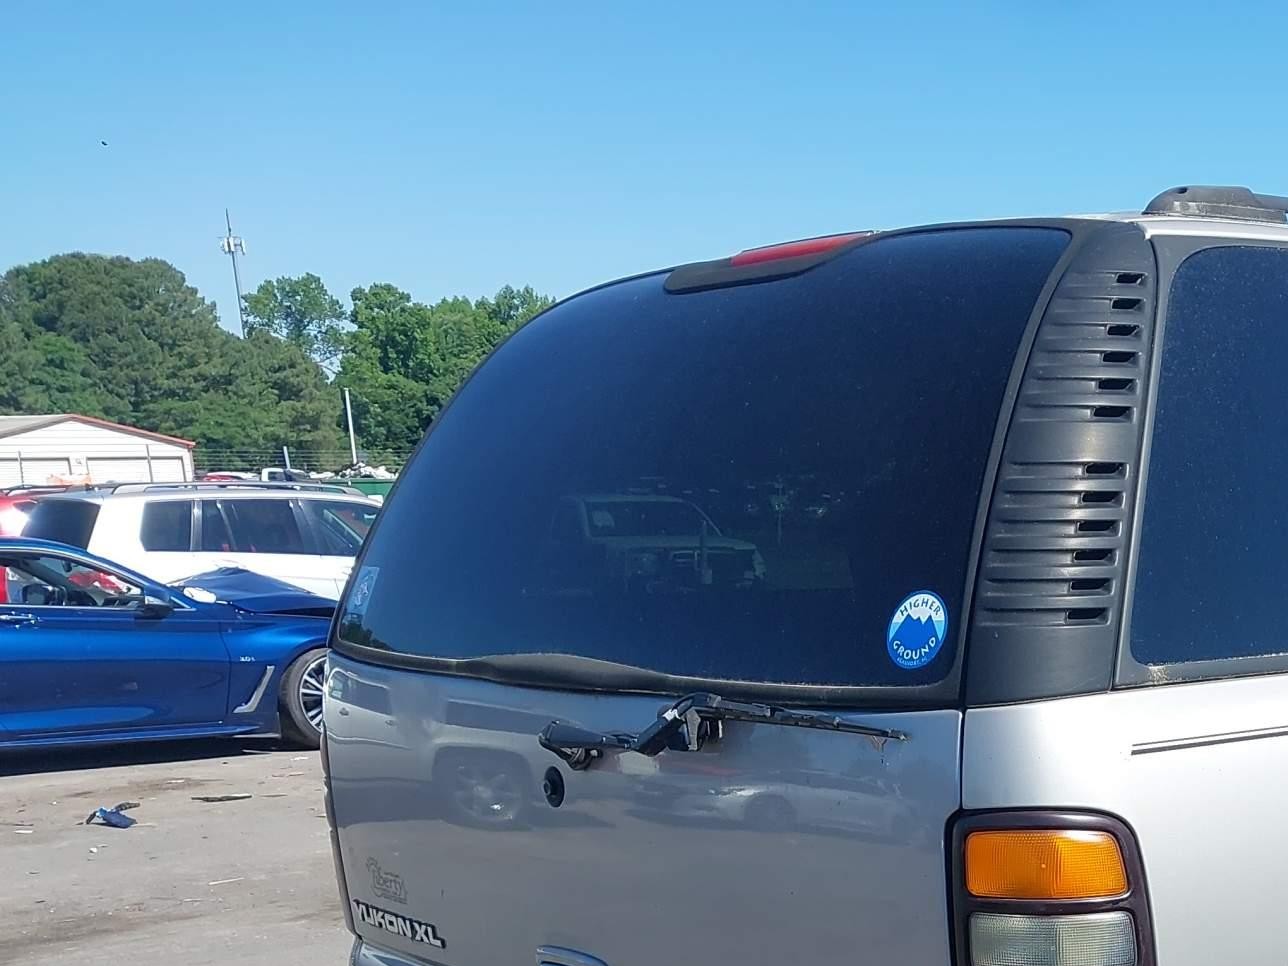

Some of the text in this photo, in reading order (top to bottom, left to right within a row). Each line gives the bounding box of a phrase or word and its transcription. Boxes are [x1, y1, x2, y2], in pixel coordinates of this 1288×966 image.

[899, 597, 942, 617] HIGHER
[893, 636, 936, 660] GROUND
[352, 898, 446, 949] YUKON XL
